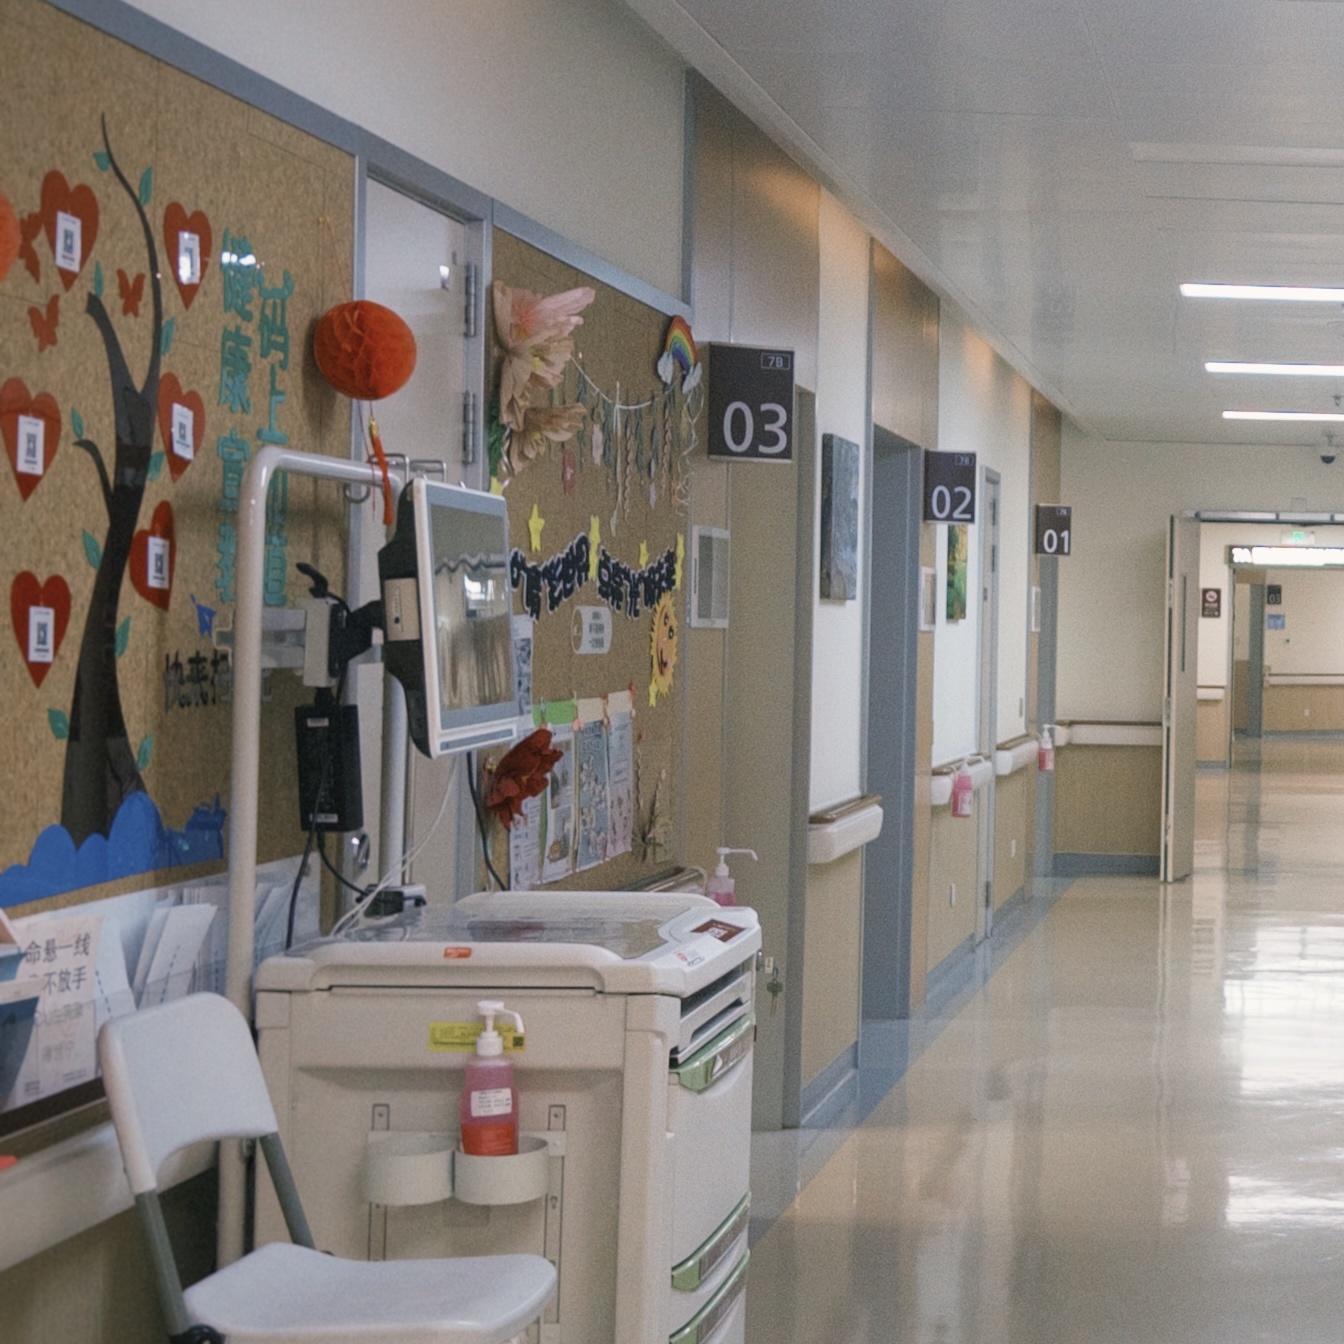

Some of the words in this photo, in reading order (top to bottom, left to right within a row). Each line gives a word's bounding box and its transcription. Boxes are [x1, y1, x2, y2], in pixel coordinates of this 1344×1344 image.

[722, 400, 788, 455] 03
[931, 484, 973, 520] 02
[1043, 528, 1070, 554] 01
[25, 932, 91, 964] 命悬一线
